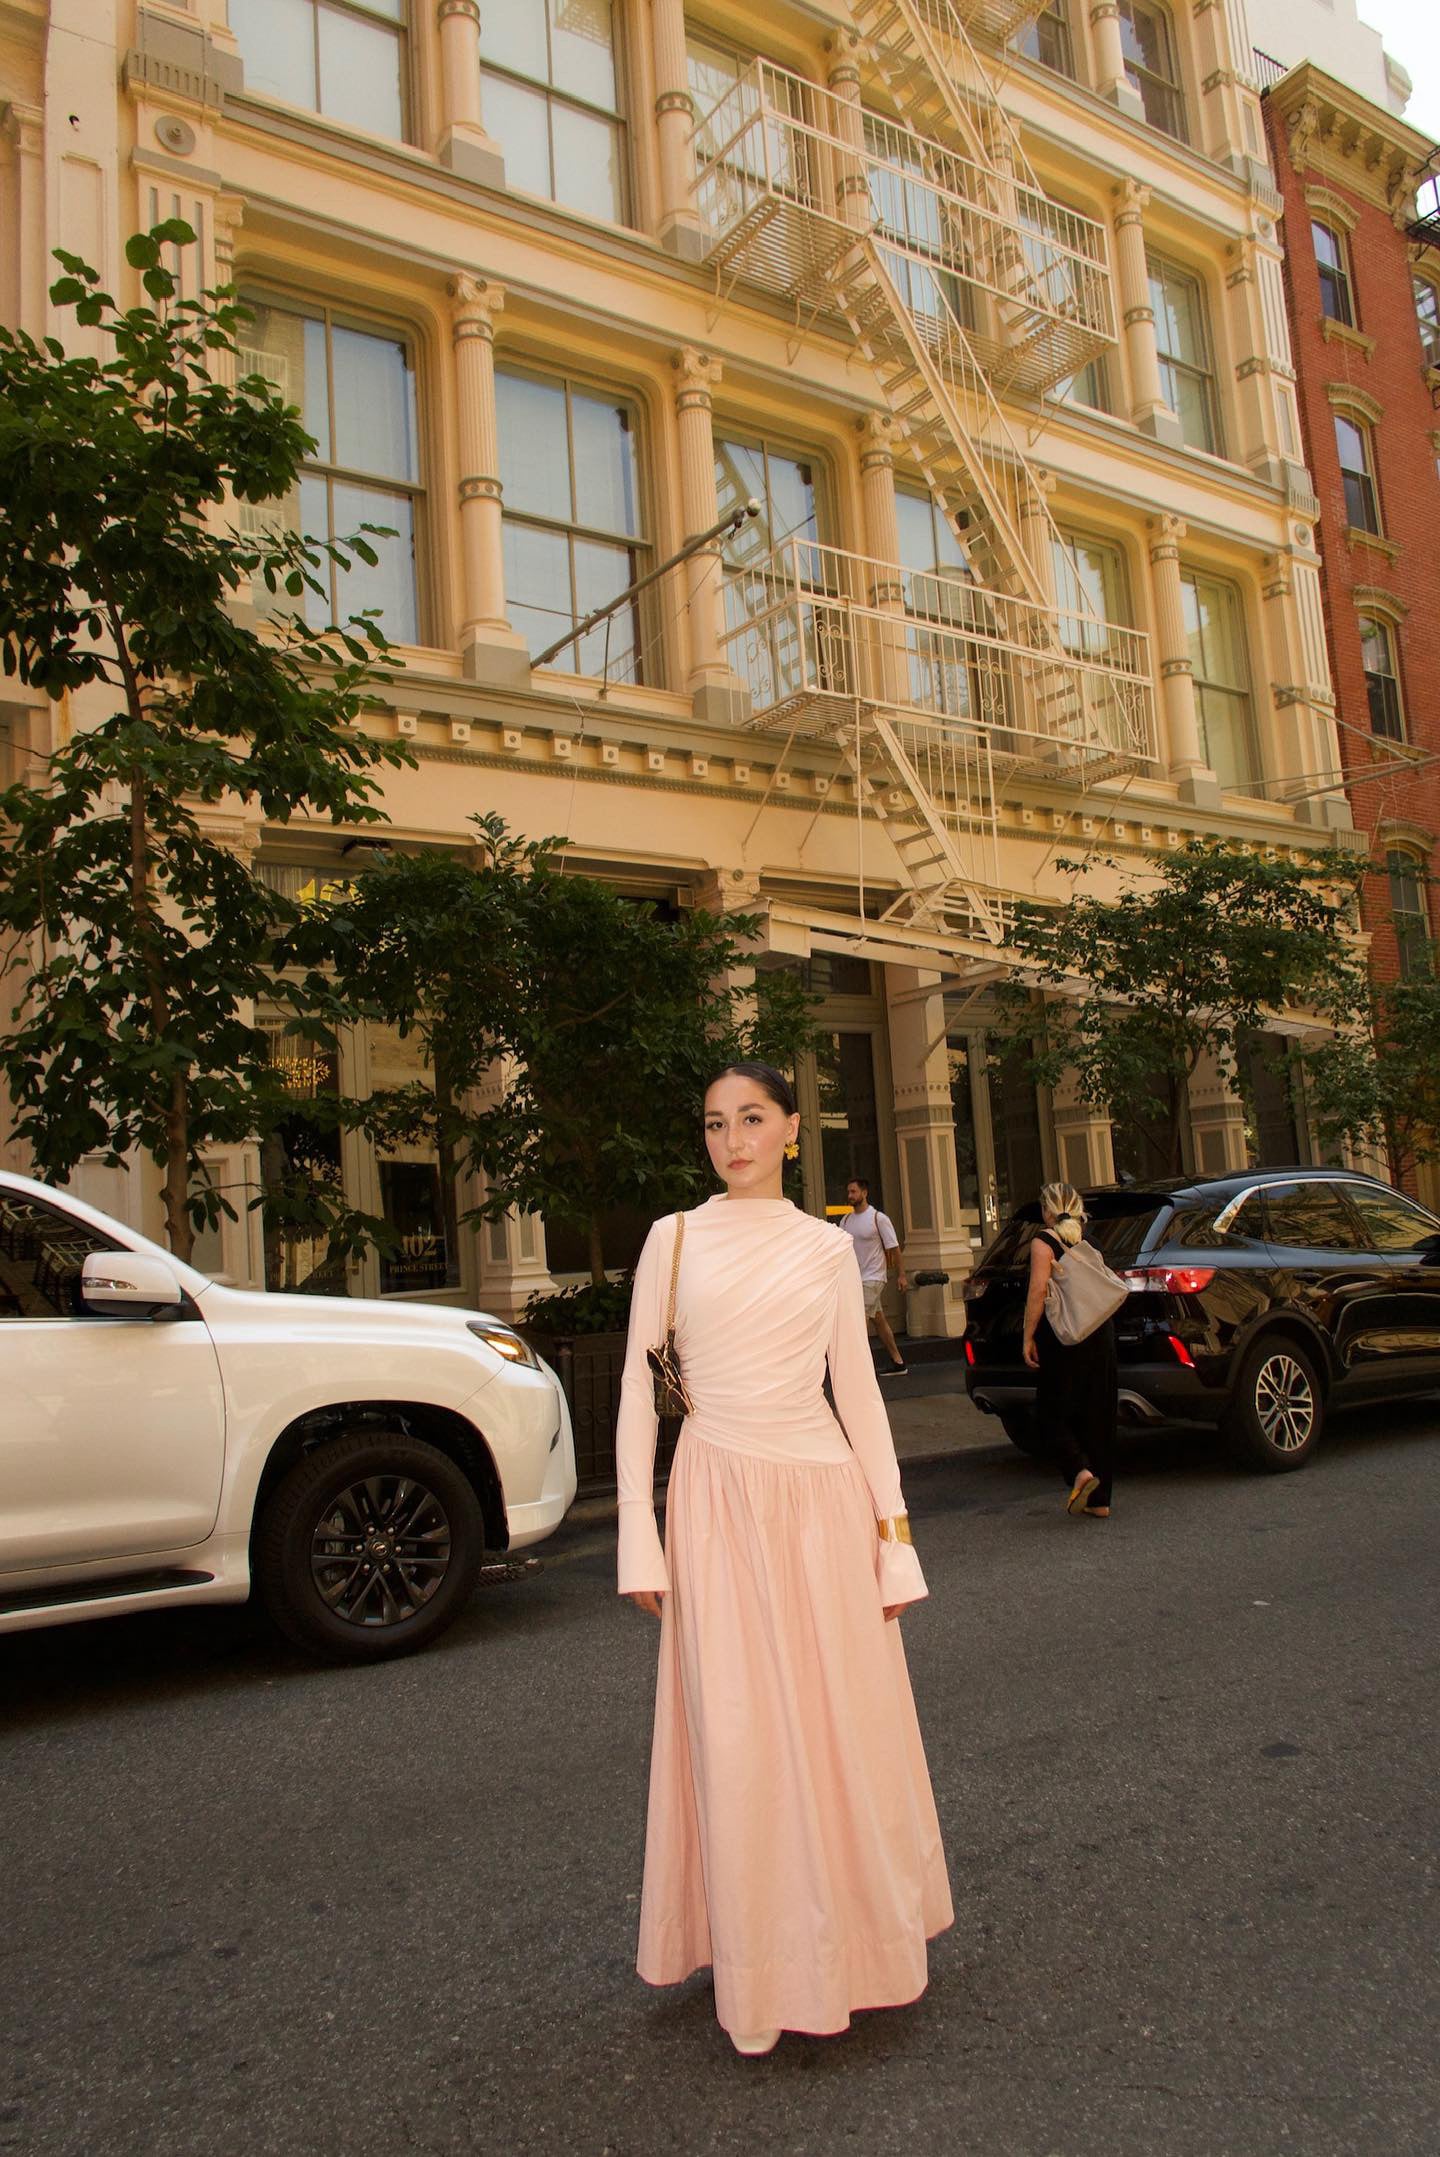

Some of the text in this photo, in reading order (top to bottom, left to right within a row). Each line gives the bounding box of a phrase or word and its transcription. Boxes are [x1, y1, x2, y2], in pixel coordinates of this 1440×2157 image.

[401, 1235, 437, 1257] 102
[389, 1263, 448, 1274] PRINCE STREET
